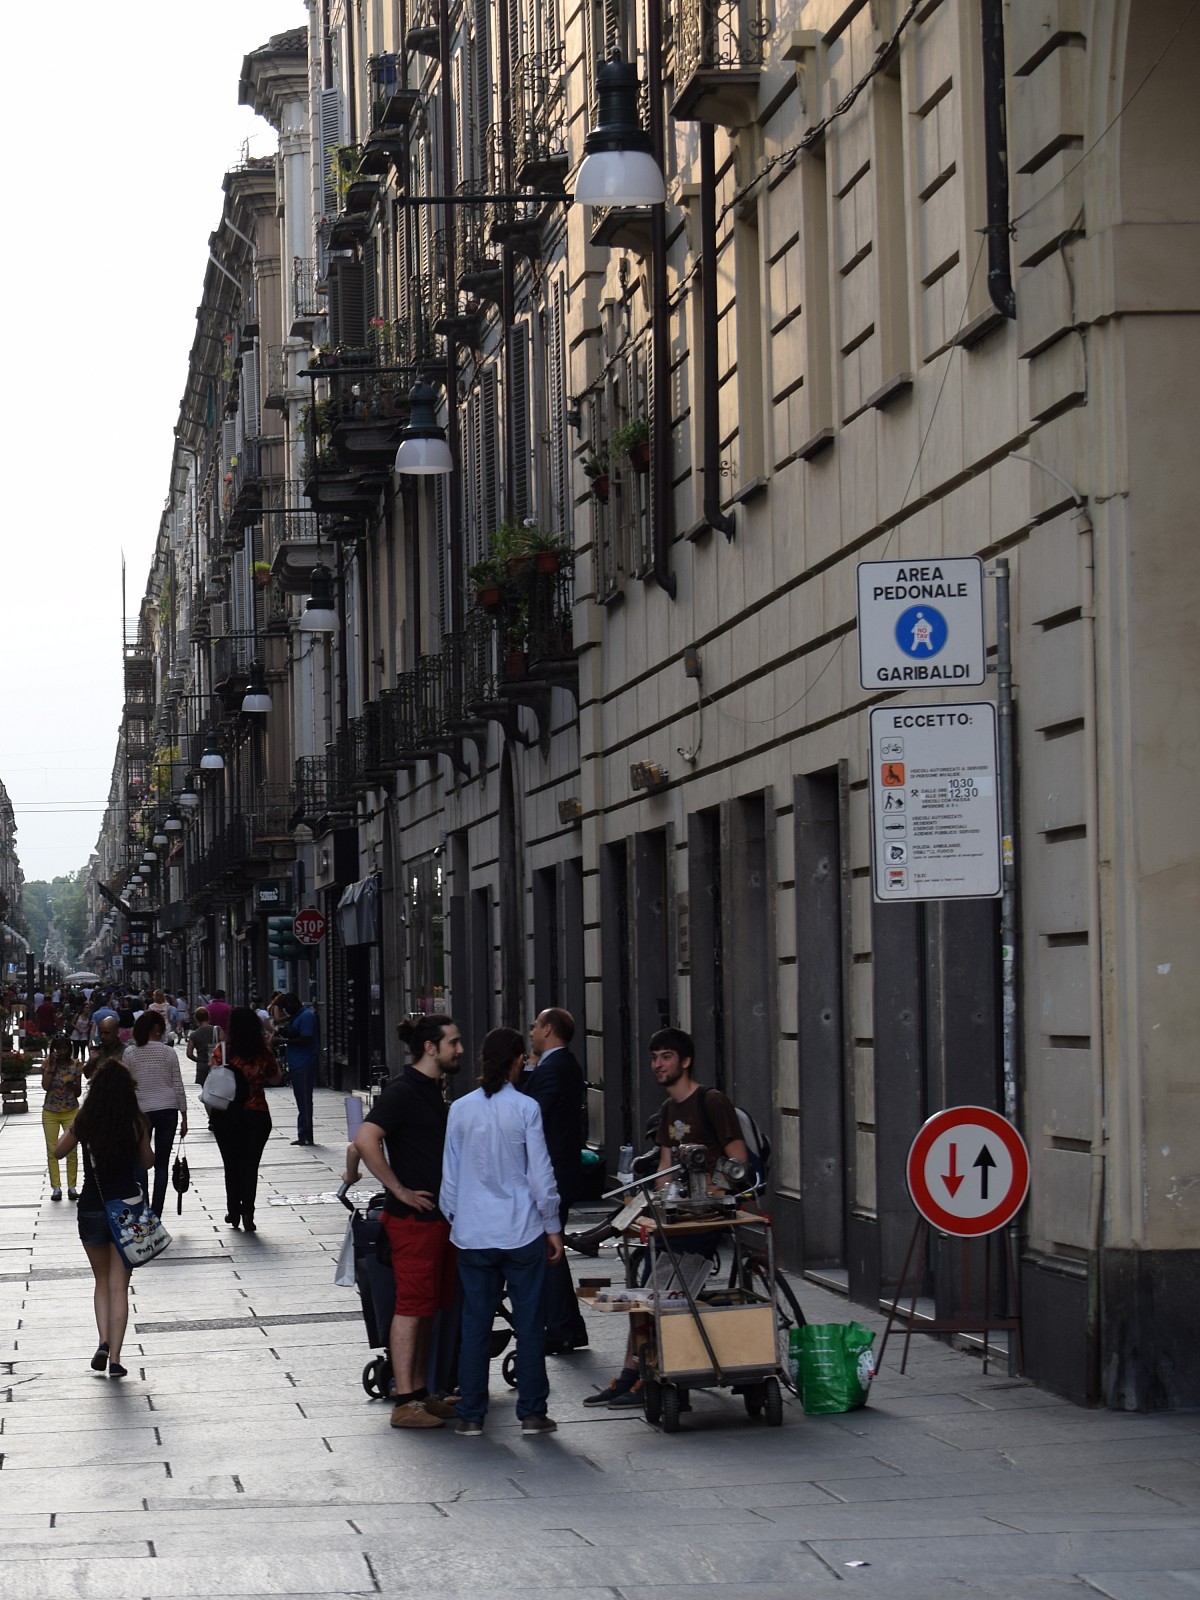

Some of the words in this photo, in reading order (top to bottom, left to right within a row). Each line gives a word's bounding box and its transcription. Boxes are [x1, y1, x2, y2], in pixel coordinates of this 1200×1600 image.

[896, 567, 944, 582] AREA
[874, 583, 968, 600] PEDONALE
[877, 664, 969, 681] GARIBALDI
[894, 713, 973, 728] ECCETTO:
[949, 788, 978, 798] 12.30
[295, 921, 324, 932] STOP
